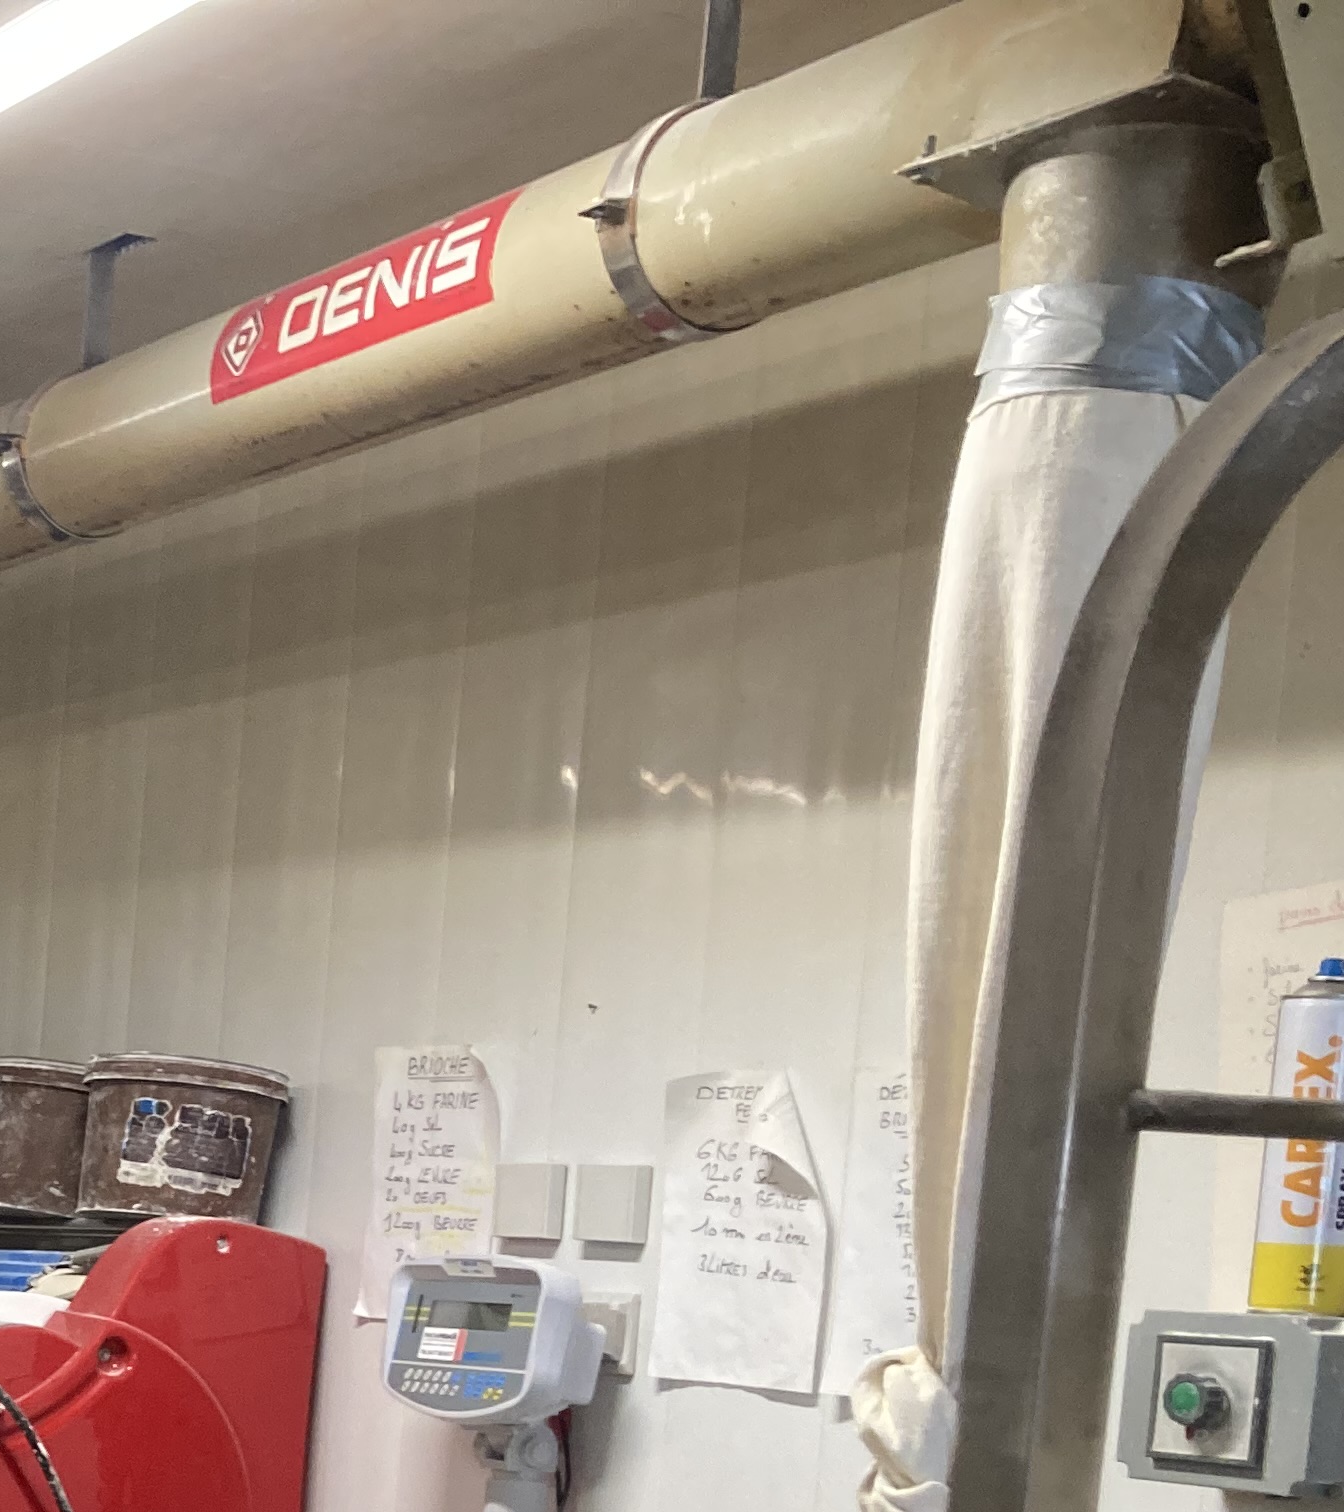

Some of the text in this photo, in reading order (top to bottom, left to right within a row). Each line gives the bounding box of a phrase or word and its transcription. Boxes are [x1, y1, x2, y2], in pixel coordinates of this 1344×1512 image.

[278, 217, 491, 353] DENIS
[407, 1055, 470, 1076] BRIOCHE
[432, 1091, 479, 1110] FARINE
[879, 1111, 908, 1130] BRI
[1279, 1032, 1342, 1229] CAREX.
